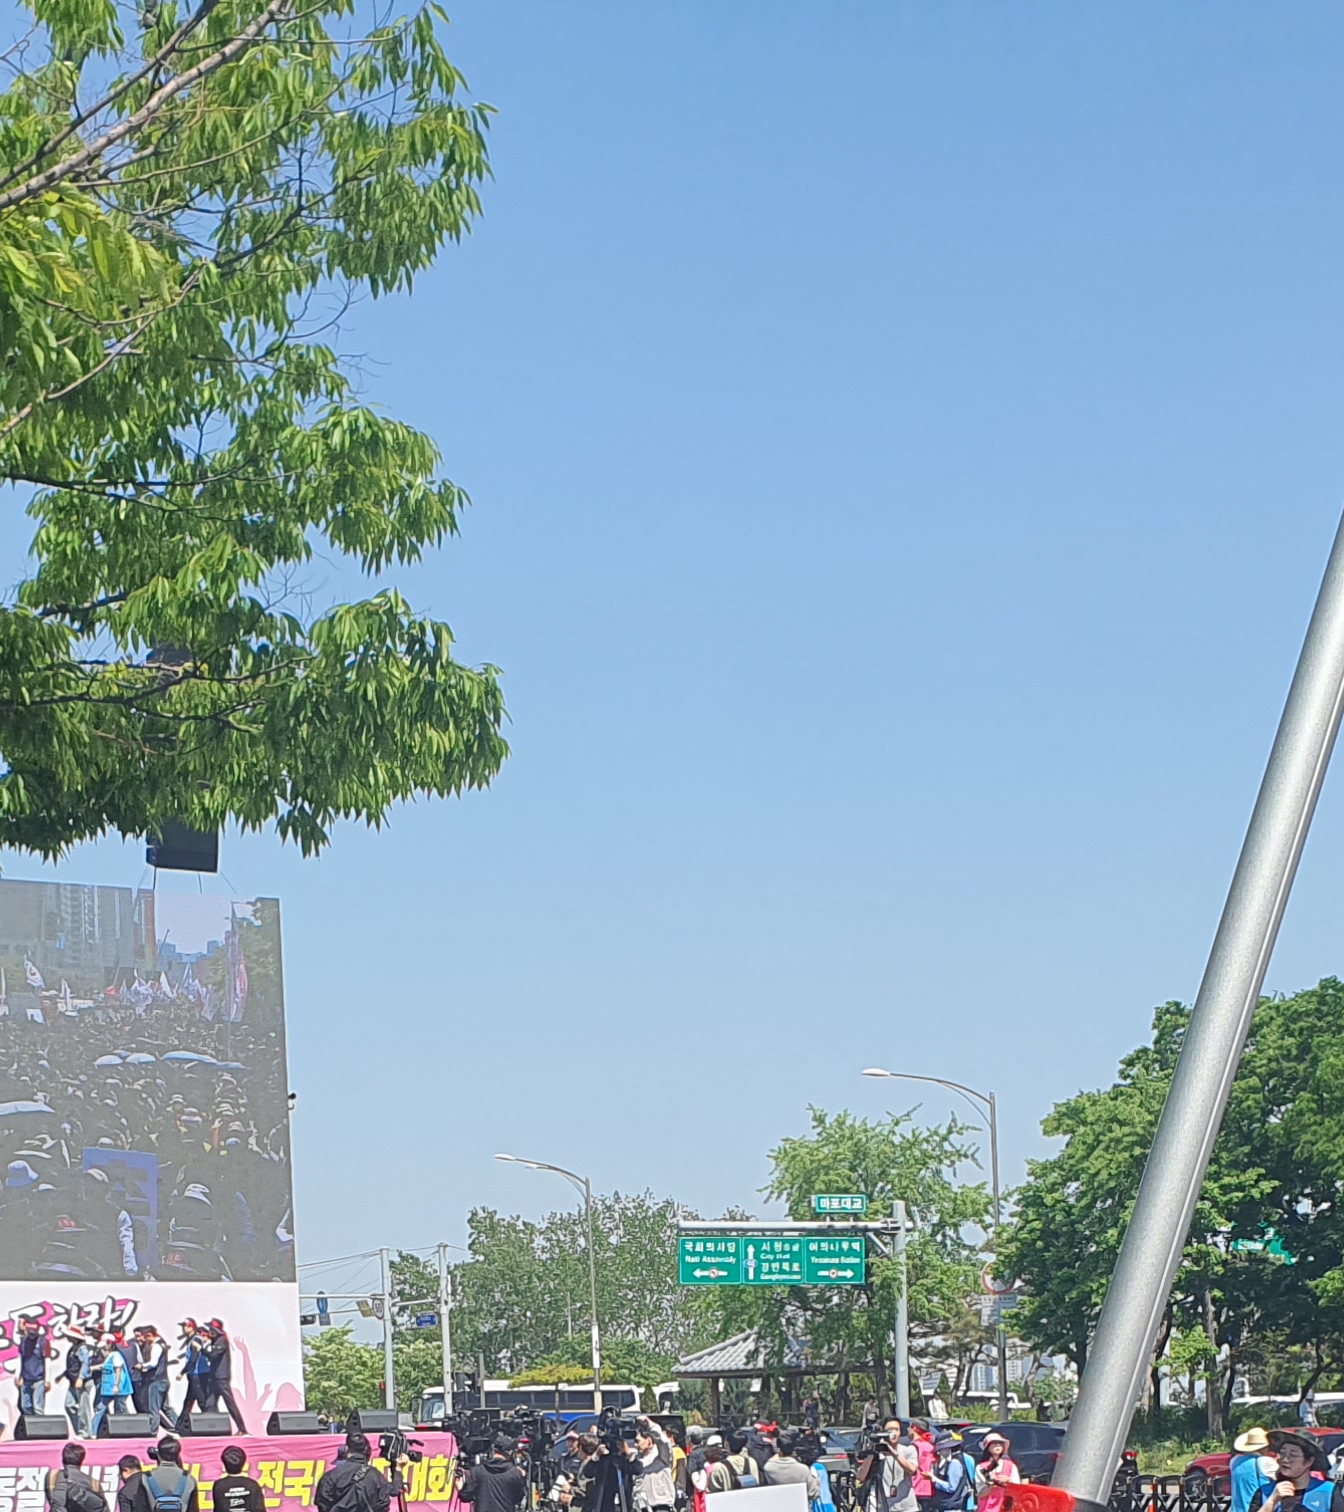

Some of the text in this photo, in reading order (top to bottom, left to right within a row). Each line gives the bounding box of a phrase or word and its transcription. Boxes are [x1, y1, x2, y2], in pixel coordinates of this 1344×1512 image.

[819, 1197, 863, 1210] 마포대교
[683, 1241, 737, 1253] 국회의사당
[808, 1241, 861, 1253] 여의나루역
